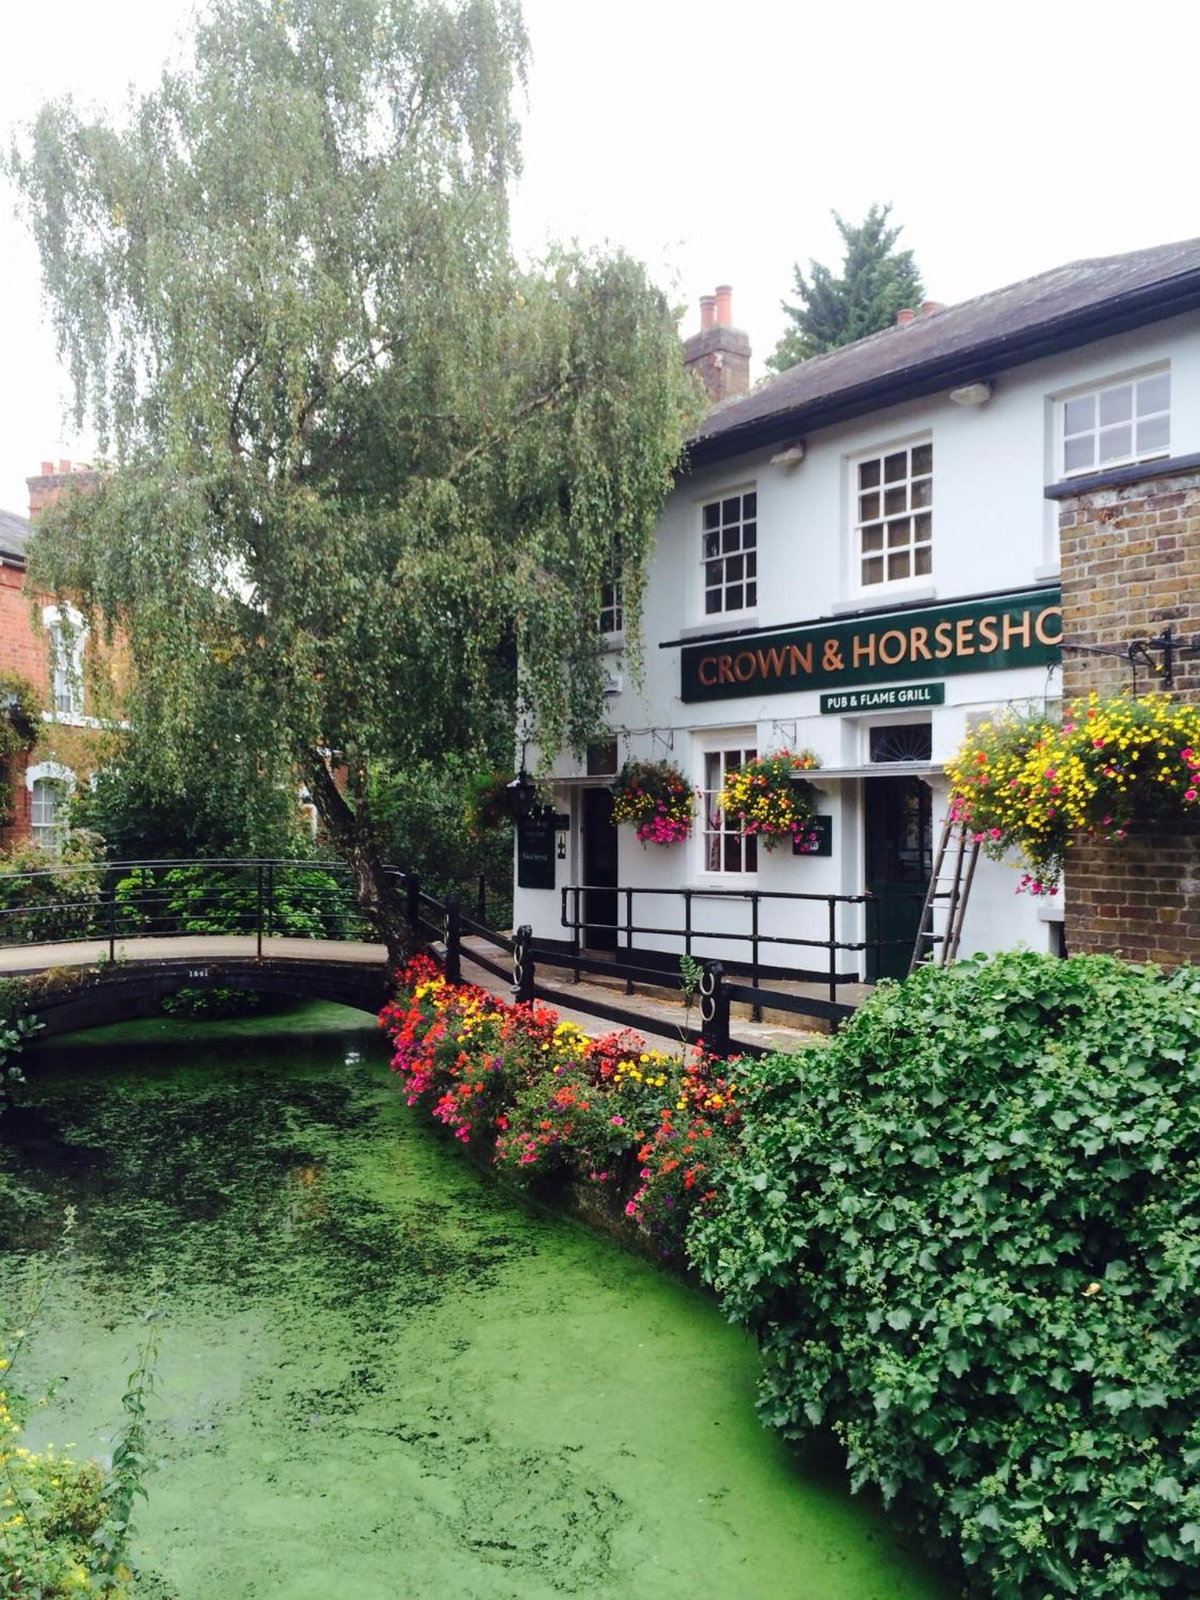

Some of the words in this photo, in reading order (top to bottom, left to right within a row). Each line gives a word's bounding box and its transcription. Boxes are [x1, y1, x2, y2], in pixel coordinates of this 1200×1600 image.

[698, 642, 813, 686] CROWN
[821, 639, 845, 672] &
[853, 606, 1063, 668] HORSESHO
[827, 696, 848, 709] PUB
[850, 695, 858, 707] &
[860, 691, 896, 706] FLAME
[898, 688, 931, 702] GRILL
